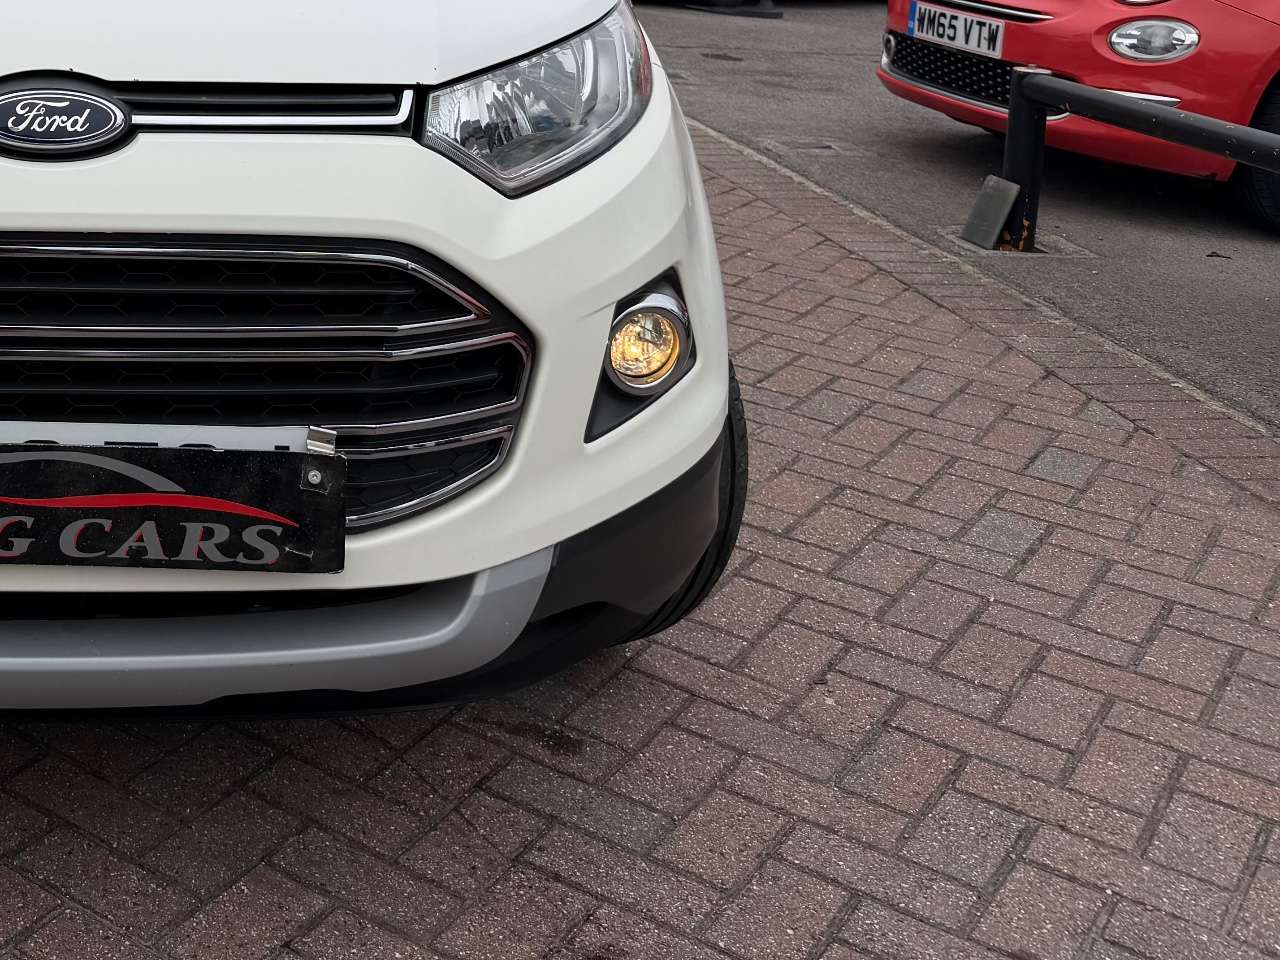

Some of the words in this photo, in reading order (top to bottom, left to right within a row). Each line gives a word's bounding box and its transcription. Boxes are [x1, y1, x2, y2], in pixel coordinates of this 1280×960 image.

[917, 6, 959, 42] WM65
[963, 17, 1000, 51] VTW
[7, 100, 91, 132] Ford
[58, 518, 285, 566] CARS
